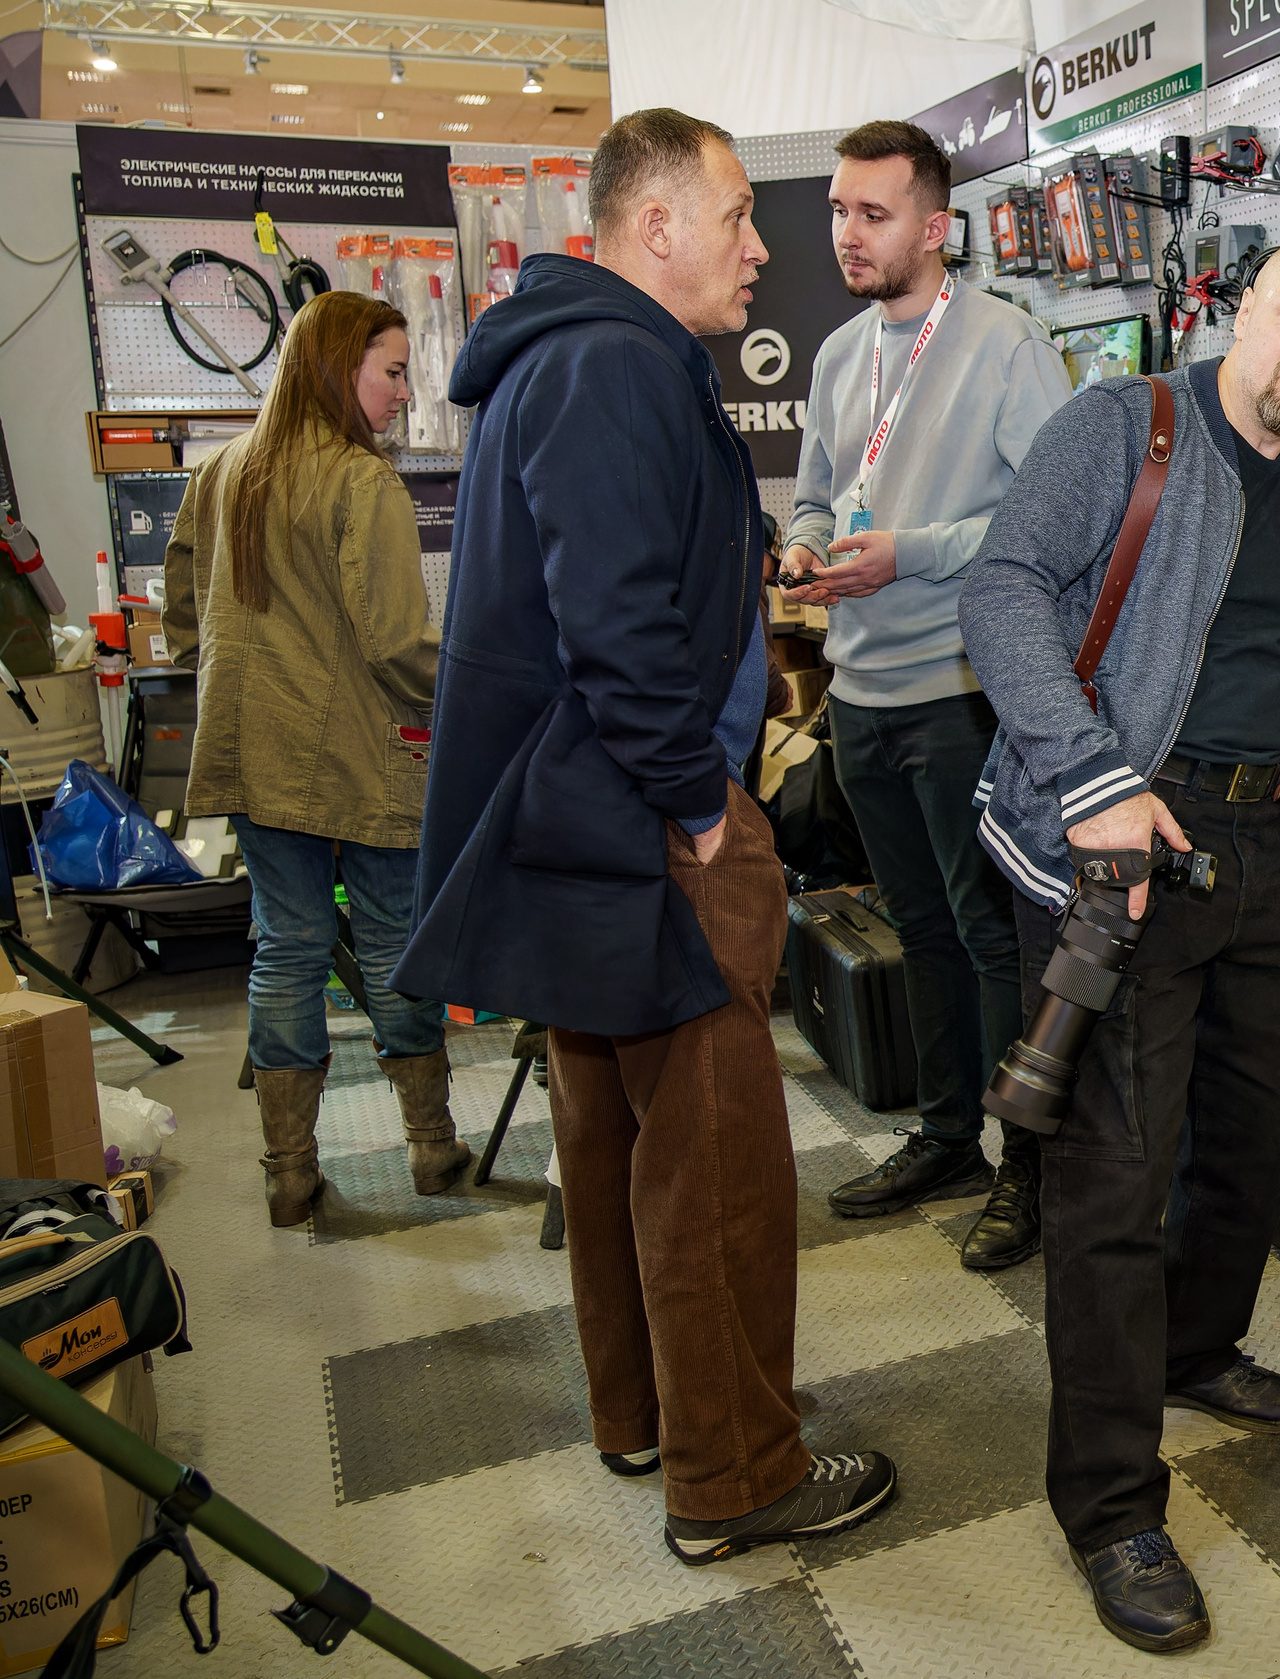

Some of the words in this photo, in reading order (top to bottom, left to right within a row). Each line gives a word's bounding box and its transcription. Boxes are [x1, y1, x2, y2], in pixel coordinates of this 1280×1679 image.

[1062, 20, 1155, 96] BERKUT
[1077, 108, 1111, 133] BERKUT
[1117, 75, 1192, 118] PROFESSIONAL
[120, 159, 237, 175] ЭЛЕКТРИЧЕСКИЕ
[239, 164, 297, 178] НАСОСЫ
[300, 167, 327, 180] ДЛЯ
[328, 169, 403, 184] ПЕРЕКАЧКИ
[121, 174, 193, 189] ТОПЛИВА
[197, 178, 208, 190] И
[318, 183, 405, 198] ЖИДКОСТЕЙ
[911, 321, 934, 365] MOTO
[867, 420, 889, 466] MOTO
[67, 1331, 118, 1363] консервы
[0, 1580, 12, 1598] S
